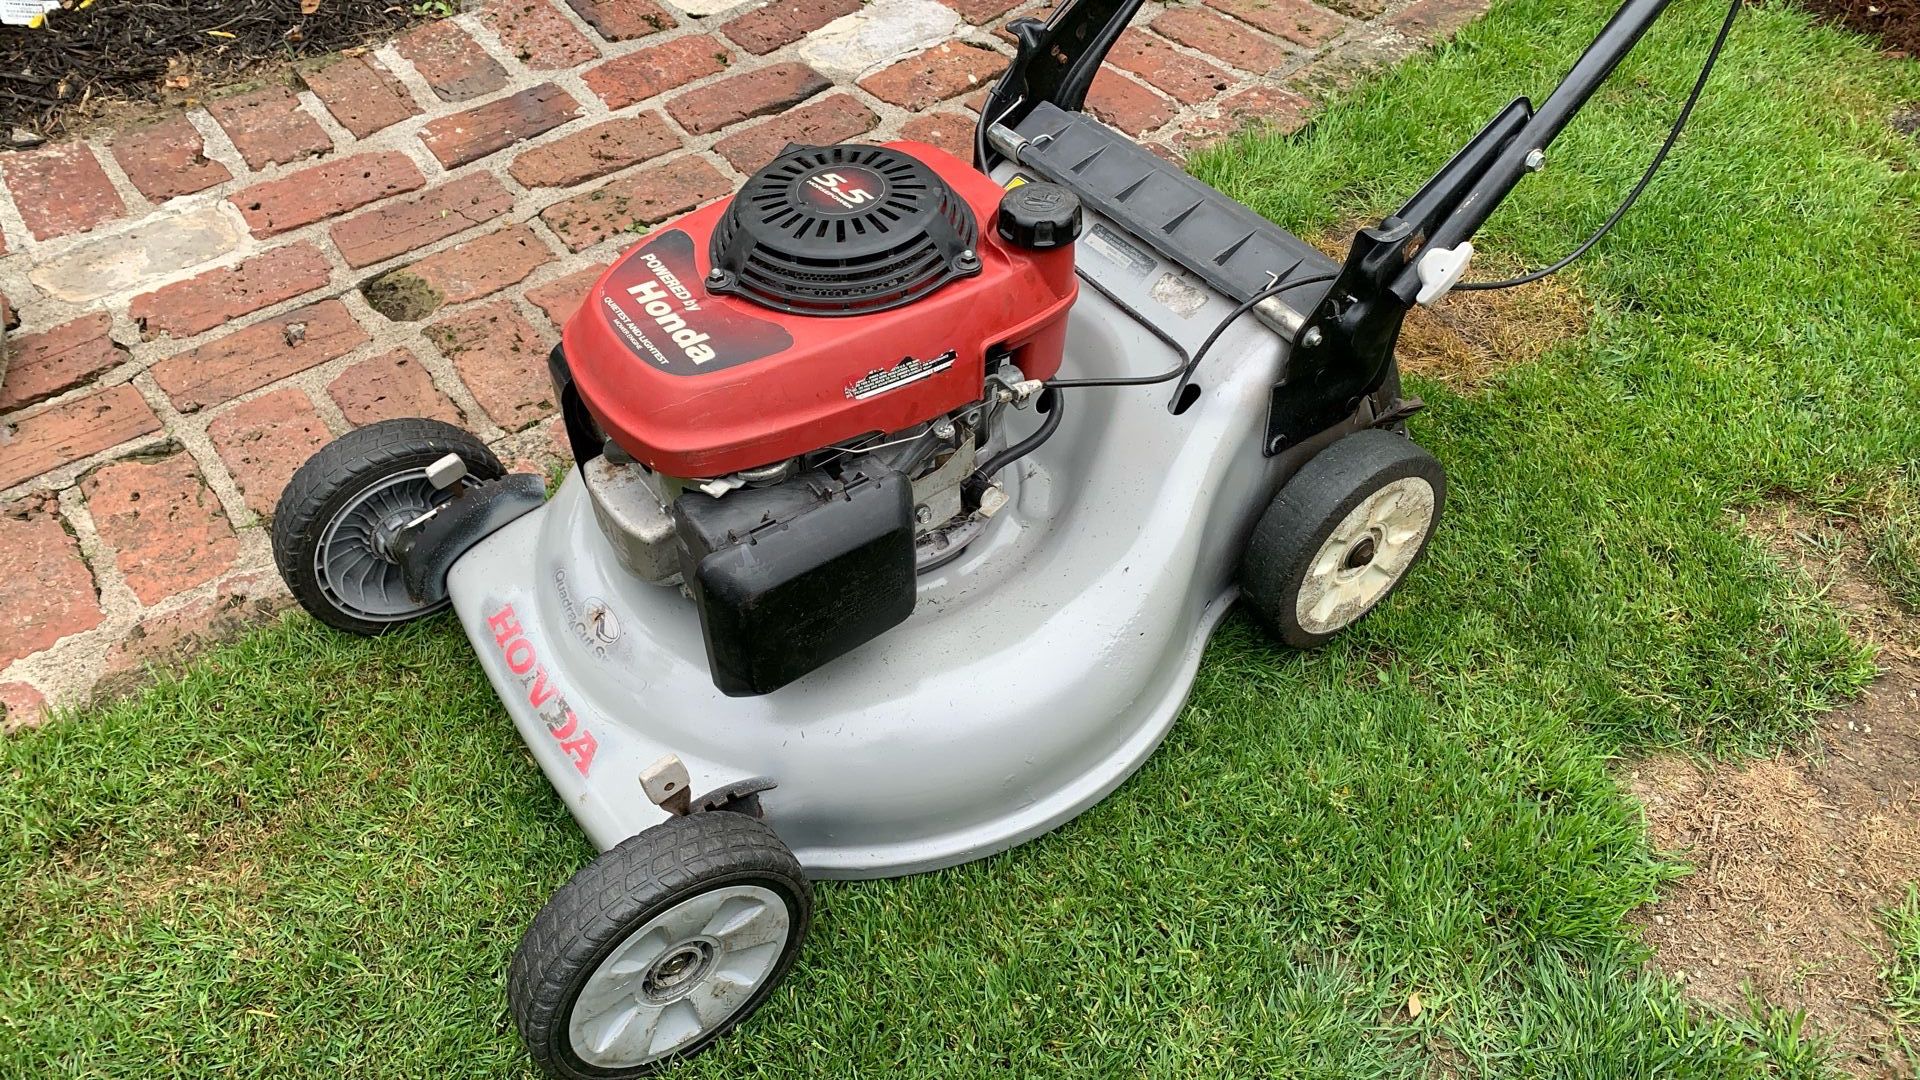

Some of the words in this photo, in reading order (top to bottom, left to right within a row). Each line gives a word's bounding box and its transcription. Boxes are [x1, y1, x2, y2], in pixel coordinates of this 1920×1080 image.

[811, 173, 875, 204] 5.5
[640, 253, 692, 300] POWERED
[682, 298, 702, 312] by
[603, 296, 632, 324] QUIETEST
[627, 321, 643, 338] AND
[639, 336, 670, 365] LIGHTEST
[613, 318, 630, 335] MOWER
[626, 280, 716, 366] Honda
[487, 602, 600, 779] HONDA
